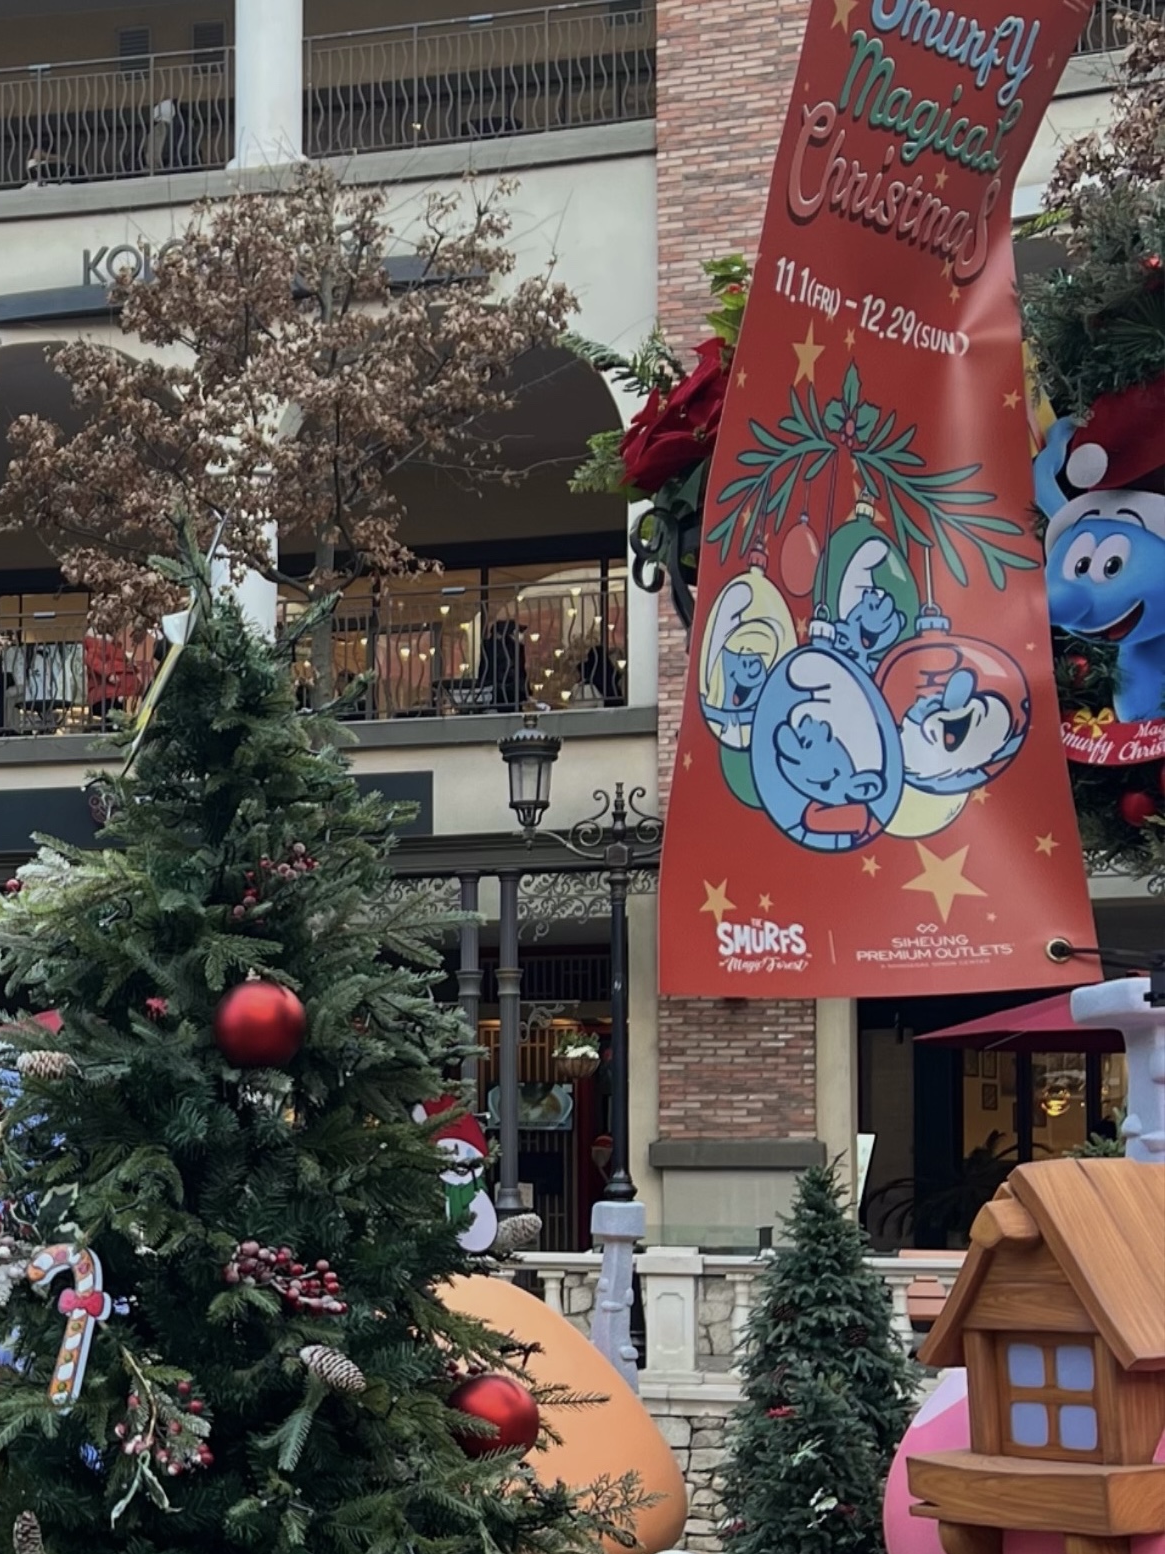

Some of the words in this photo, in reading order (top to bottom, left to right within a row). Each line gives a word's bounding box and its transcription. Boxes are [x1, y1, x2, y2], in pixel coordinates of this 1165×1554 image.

[839, 30, 1024, 171] Magical
[788, 102, 1002, 280] Christmas
[775, 257, 841, 316] 11.1(FRI)
[860, 294, 970, 357] 12.29(SUN)
[717, 921, 807, 956] SMURFS
[856, 950, 932, 962] PREMIUM
[935, 943, 1014, 959] OUTLETS
[891, 934, 969, 949] SIHEUNG
